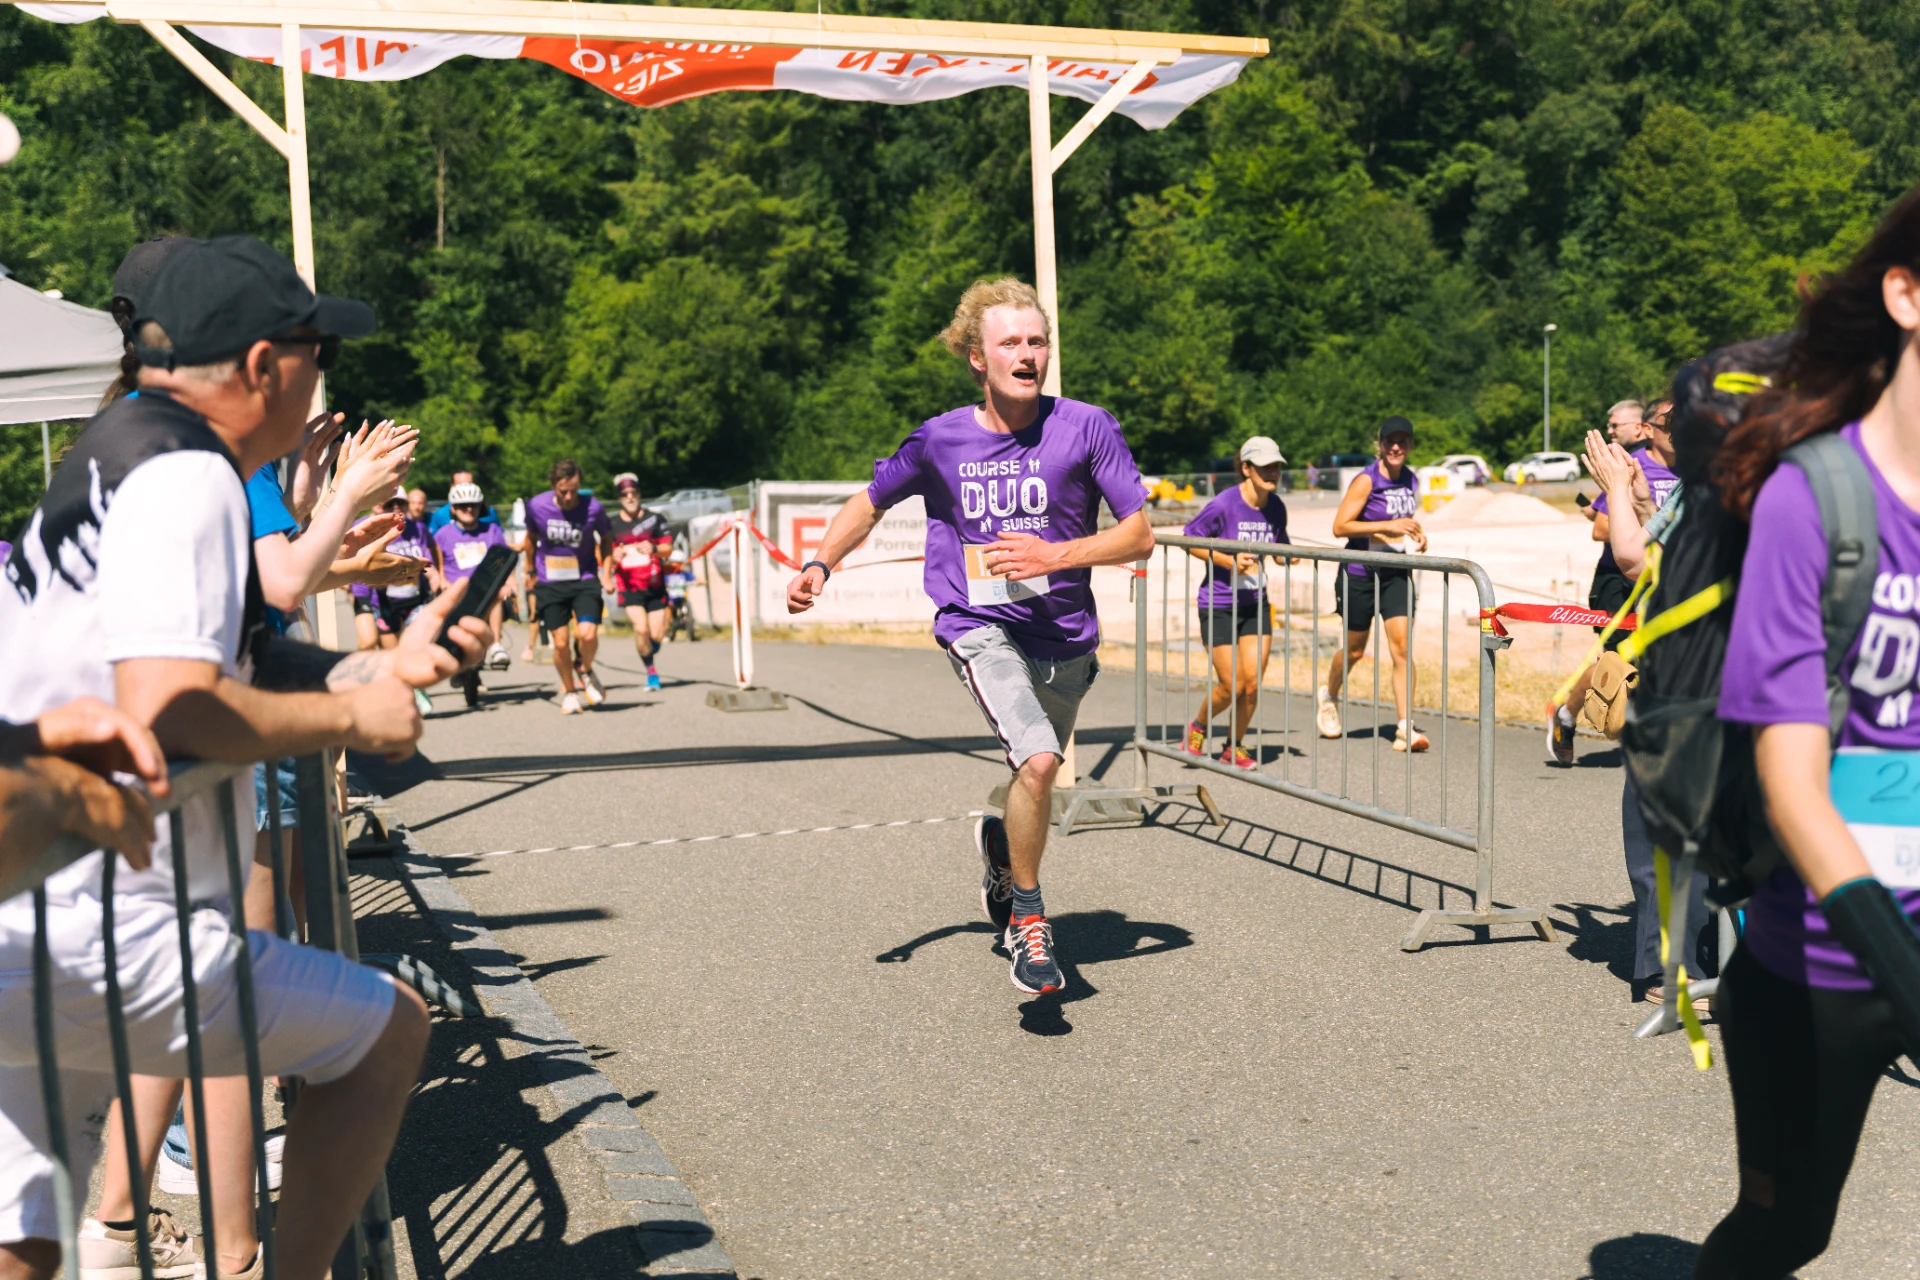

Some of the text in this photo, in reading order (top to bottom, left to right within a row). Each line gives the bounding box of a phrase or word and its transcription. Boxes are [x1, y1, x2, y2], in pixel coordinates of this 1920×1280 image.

[959, 460, 1020, 477] COURSE
[961, 477, 1048, 519] DUO
[1385, 494, 1416, 515] DUO
[876, 516, 927, 530] ernan
[1001, 516, 1049, 532] SUISSE
[875, 537, 926, 551] Porren
